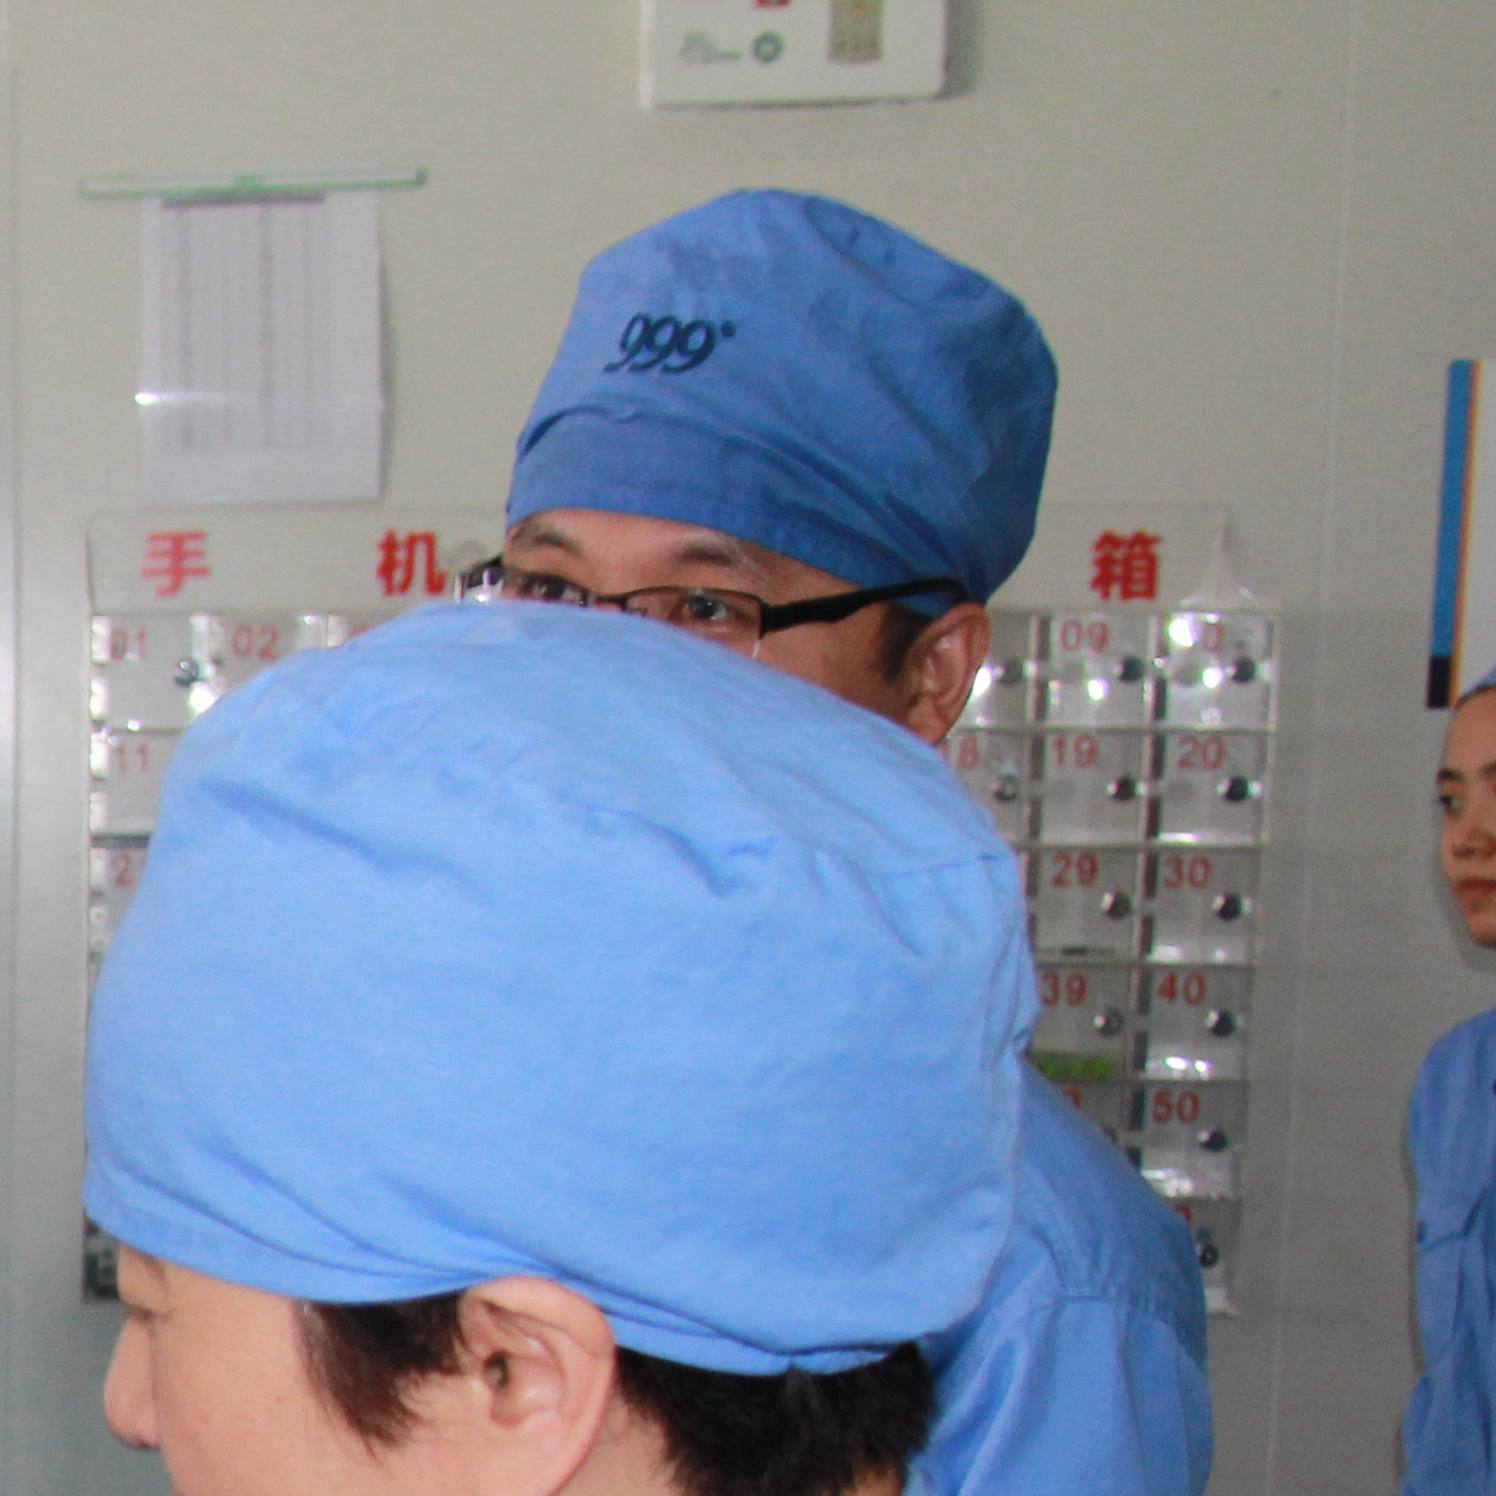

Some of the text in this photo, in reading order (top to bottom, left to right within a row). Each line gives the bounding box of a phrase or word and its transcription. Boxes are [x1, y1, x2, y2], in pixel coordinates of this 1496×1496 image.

[604, 312, 718, 373] 999
[1090, 529, 1161, 602] 箱
[231, 624, 280, 661] 02
[1053, 735, 1099, 769] 19
[1176, 736, 1227, 770] 20
[1050, 853, 1099, 888] 29
[1164, 856, 1213, 890] 30
[1158, 971, 1207, 1006] 40
[1152, 1090, 1201, 1124] 50
